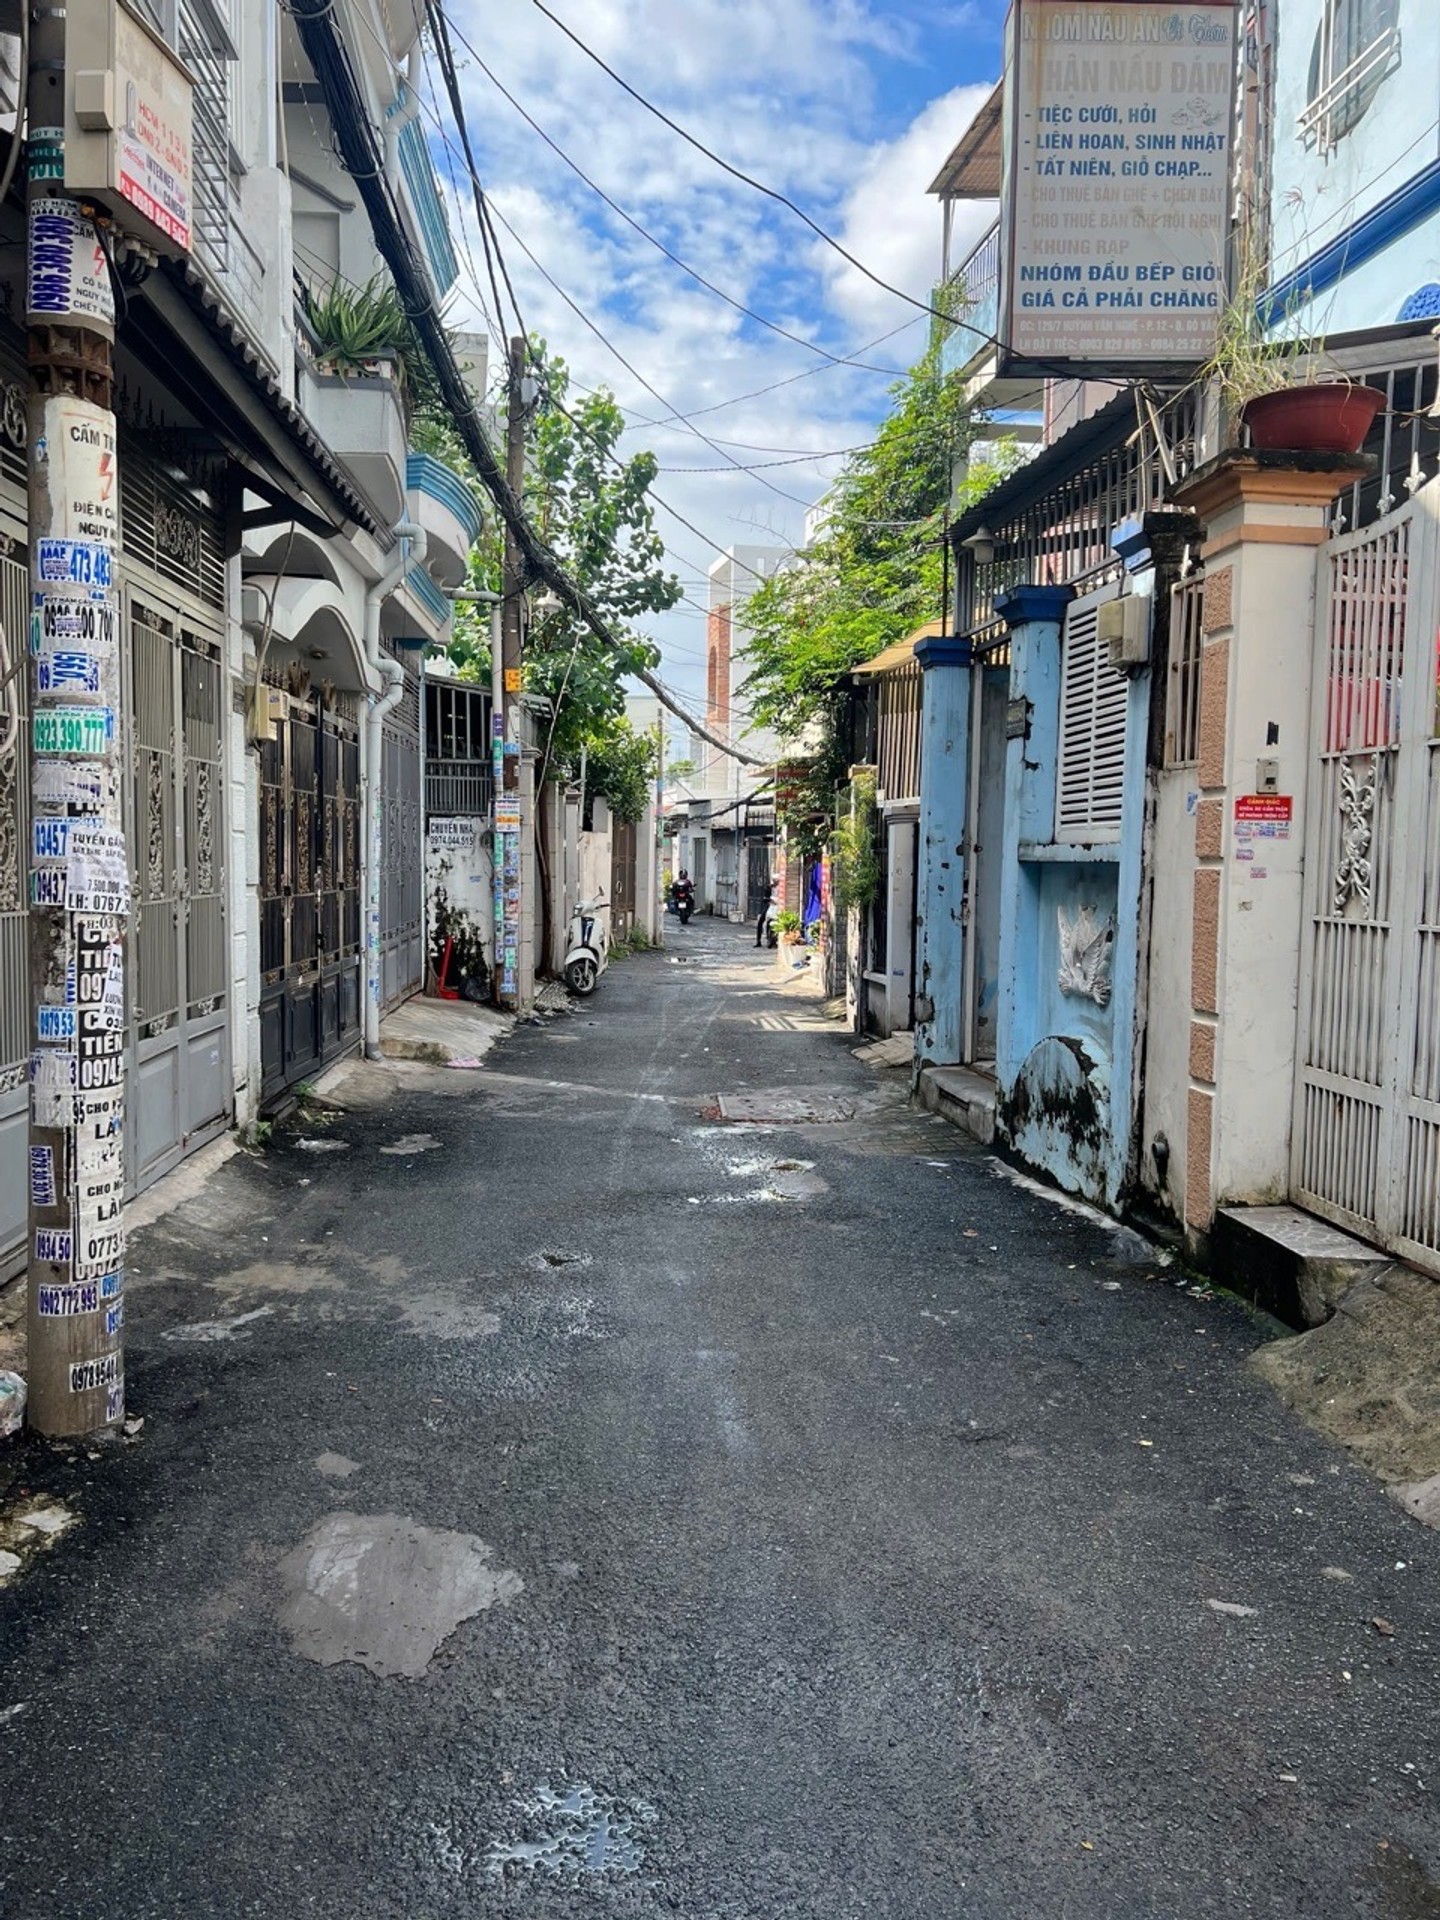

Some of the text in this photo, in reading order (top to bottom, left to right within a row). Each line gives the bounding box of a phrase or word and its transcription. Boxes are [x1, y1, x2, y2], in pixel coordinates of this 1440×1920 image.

[1037, 104, 1073, 125] TIỆC
[1128, 103, 1157, 123] HỎI
[1036, 131, 1073, 149] LIÊN
[1079, 134, 1130, 151] HOAN,
[1135, 134, 1176, 150] SINH
[1182, 132, 1226, 154] NHẬT
[1036, 155, 1065, 175] TẤT
[1069, 158, 1116, 177] NIÊN,
[1020, 262, 1082, 281] NHÓM
[1135, 260, 1175, 281] BẾP
[1021, 288, 1055, 307] GIÁ
[1062, 286, 1089, 307] CẢ
[1095, 286, 1143, 307] PHẢI
[70, 423, 100, 446] CẤM
